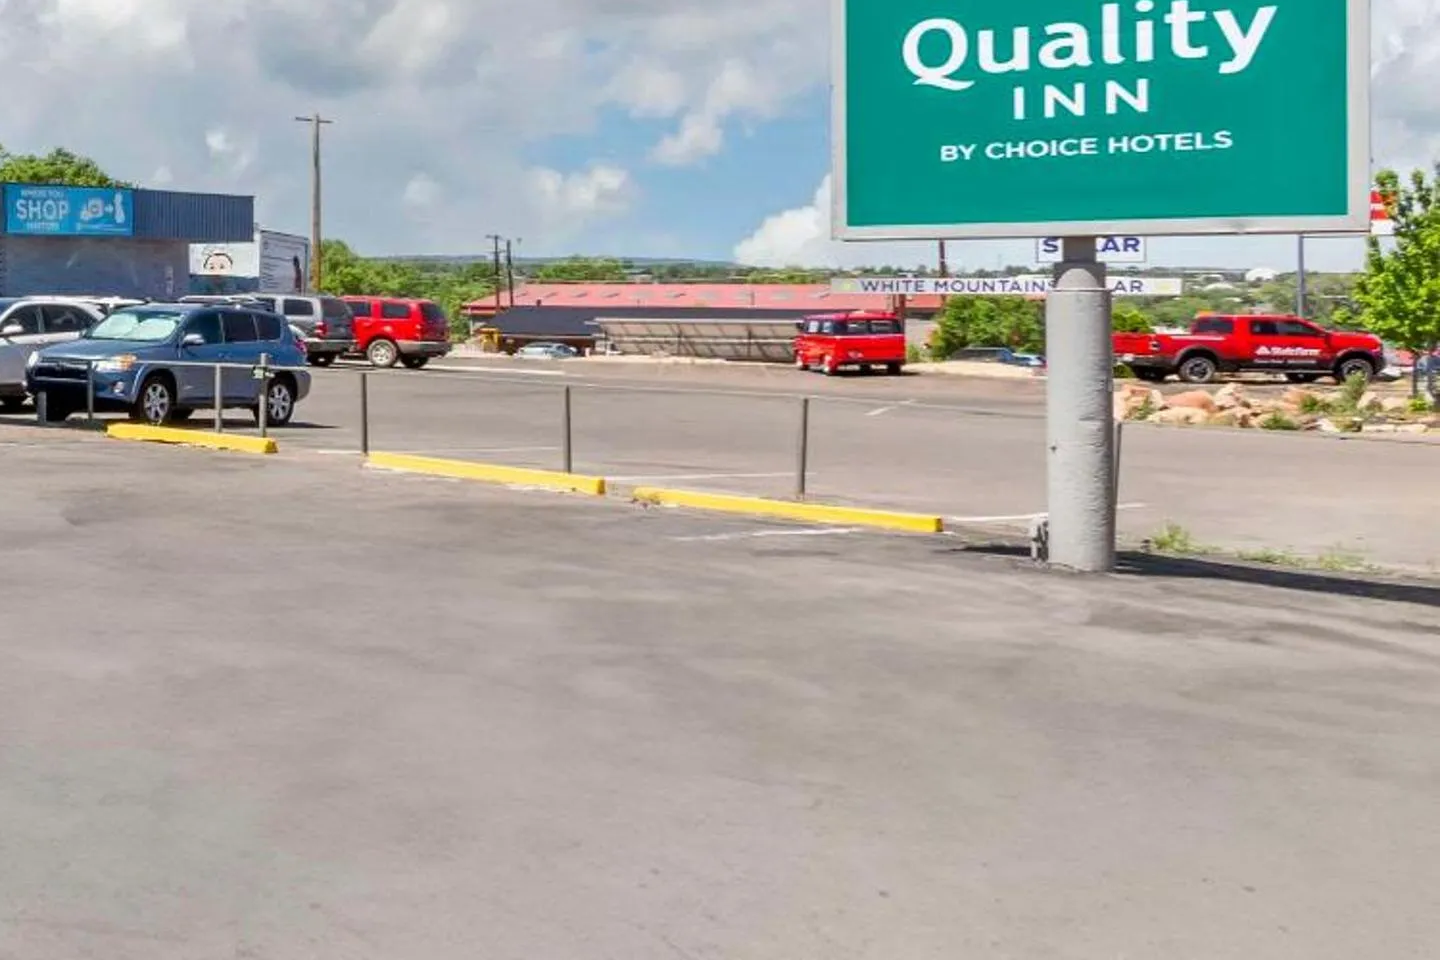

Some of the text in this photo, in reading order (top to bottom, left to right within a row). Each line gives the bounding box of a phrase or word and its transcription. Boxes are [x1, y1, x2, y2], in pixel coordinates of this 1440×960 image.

[902, 0, 1277, 91] Quality
[1013, 78, 1149, 120] INN
[940, 130, 1233, 162] BY CHOICE HOTELS
[16, 199, 68, 221] SHOP
[1043, 236, 1140, 252] SAR
[861, 280, 925, 292] WHITE
[934, 280, 1046, 292] MOUNTAIN
